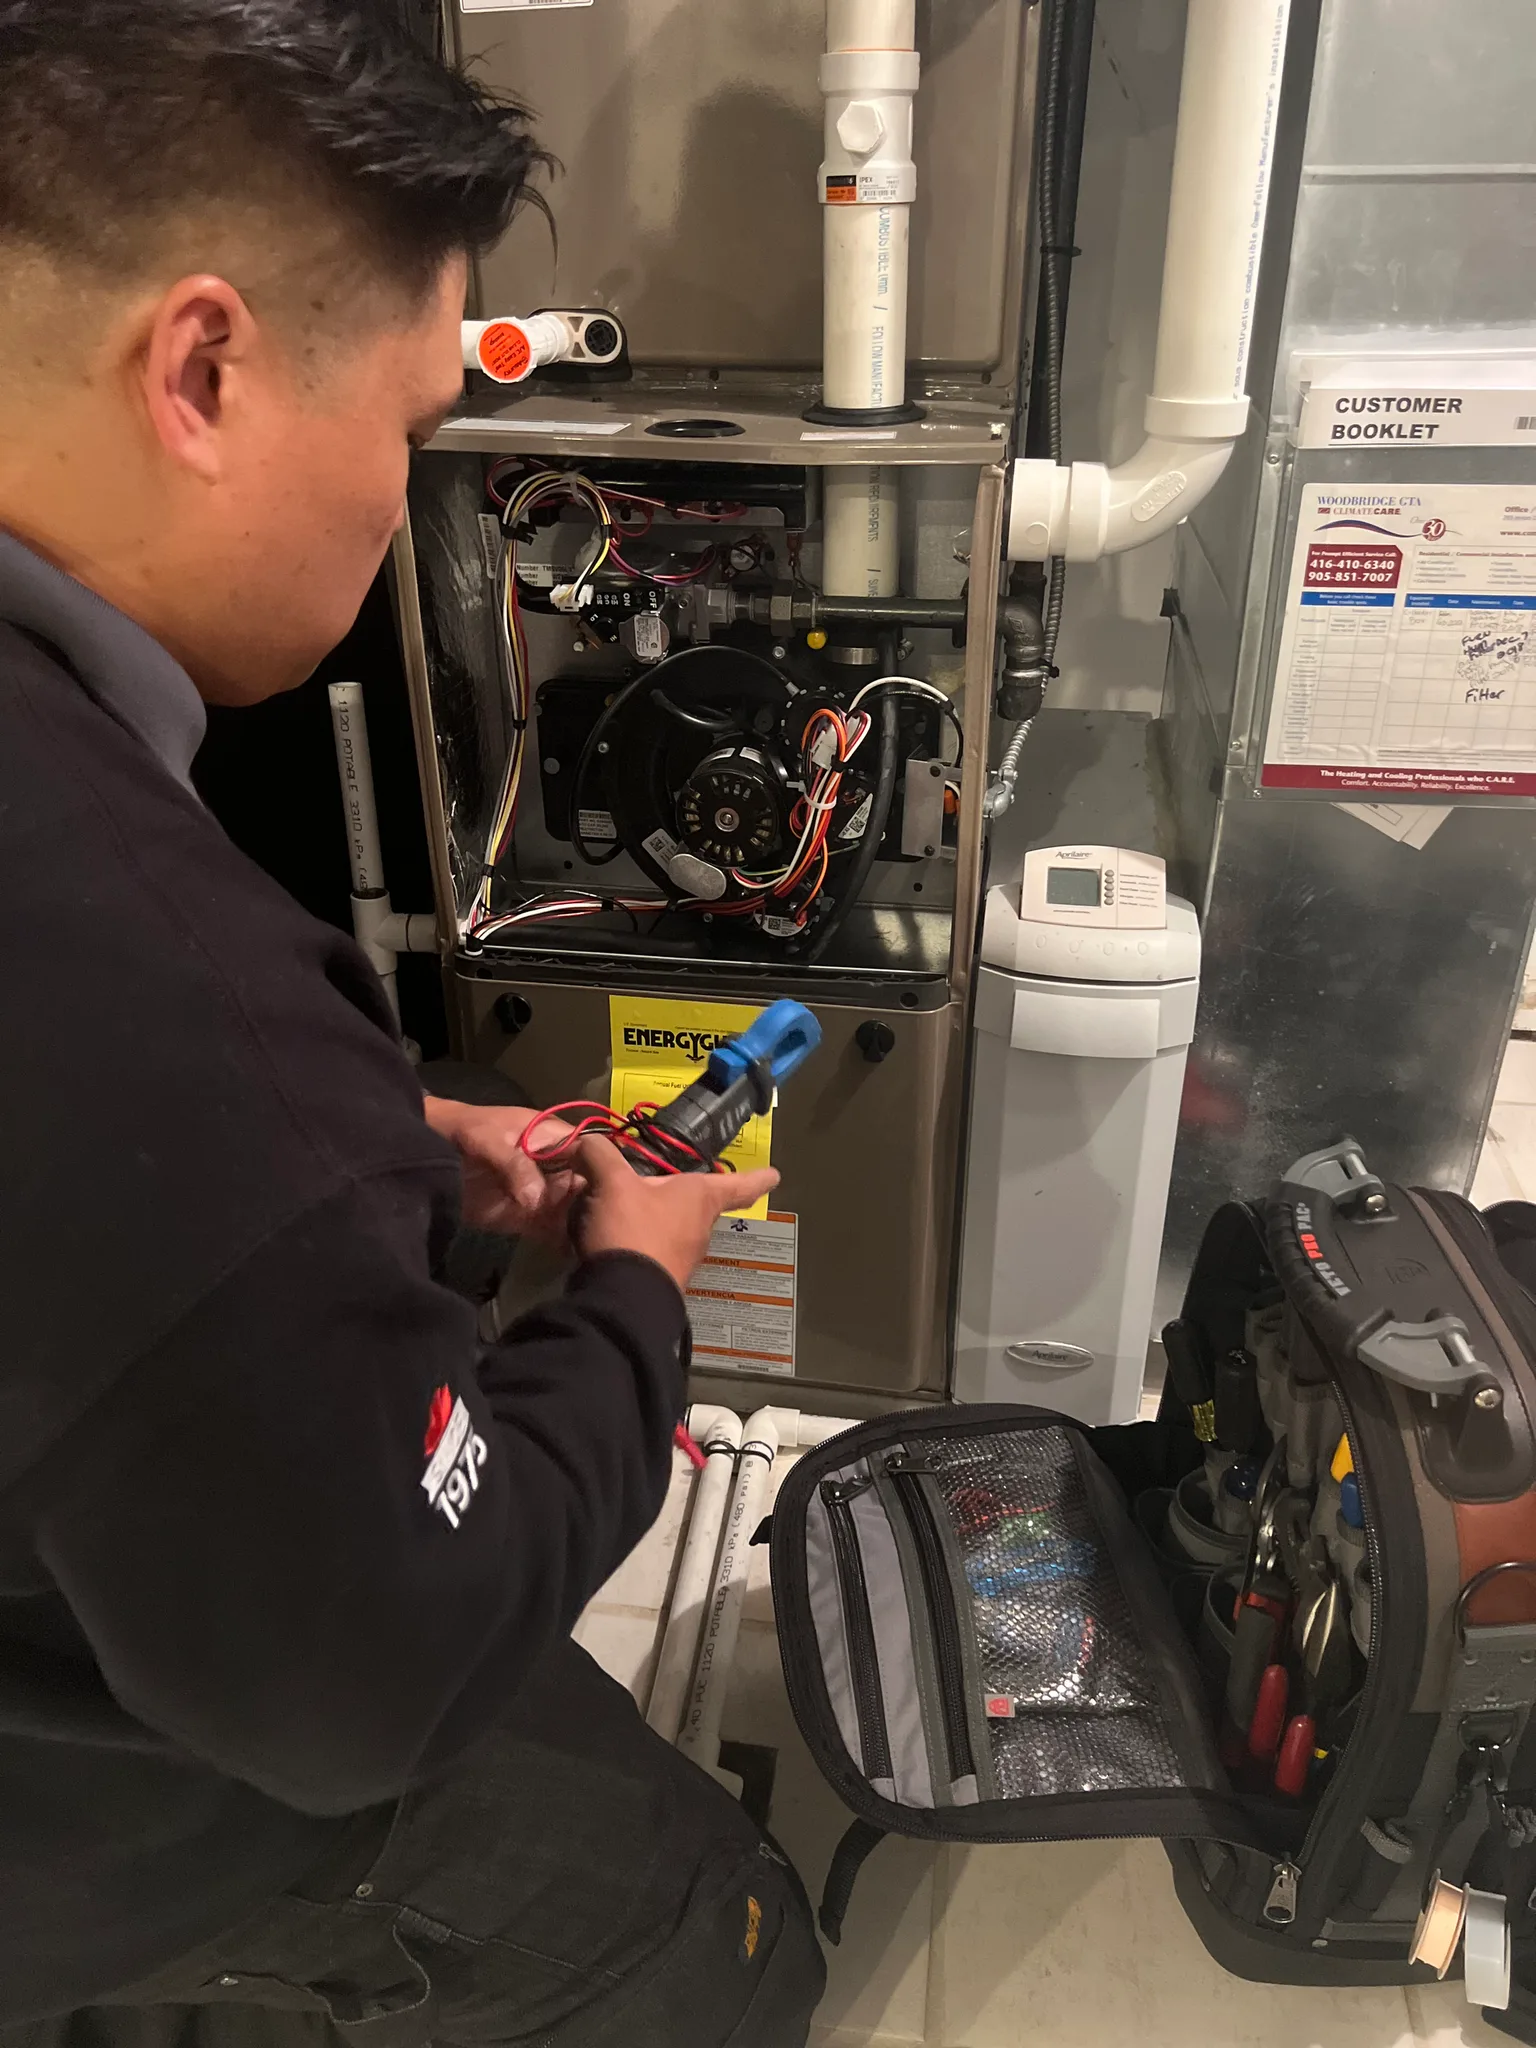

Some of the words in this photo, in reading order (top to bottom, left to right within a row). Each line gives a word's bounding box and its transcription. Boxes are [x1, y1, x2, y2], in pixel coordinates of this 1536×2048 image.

[1335, 398, 1463, 414] CUSTOMER
[1331, 423, 1440, 440] BOOKLET
[1317, 496, 1396, 506] WOODBRIDGE
[1310, 560, 1395, 570] 416-410-6340
[1308, 572, 1393, 582] 905-851-7007
[623, 592, 631, 607] ON
[649, 591, 657, 608] OFF
[1336, 771, 1366, 779] Heating
[1384, 773, 1413, 781] Cooling
[1415, 774, 1465, 782] Professionals
[1372, 781, 1419, 789] Accountability.
[1455, 783, 1490, 791] Excellence.
[1055, 851, 1092, 859] Aprilaire
[702, 1643, 715, 1671] 1120
[720, 1556, 733, 1583] 3310
